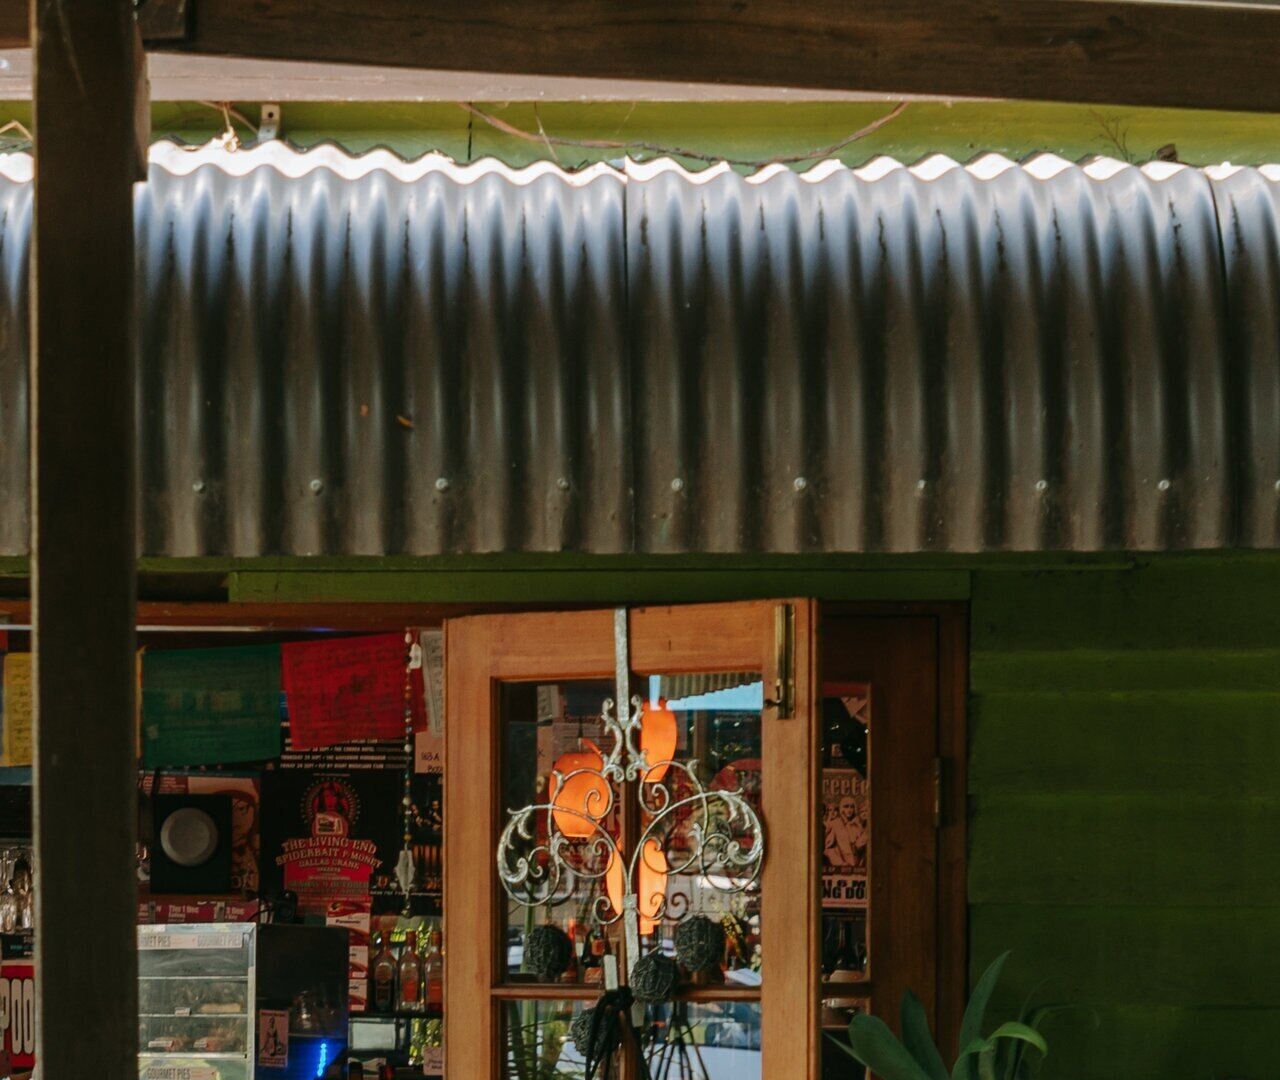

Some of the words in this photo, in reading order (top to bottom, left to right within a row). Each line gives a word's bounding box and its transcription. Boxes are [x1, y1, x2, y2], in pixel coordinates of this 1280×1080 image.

[281, 839, 306, 852] THE
[309, 837, 349, 848] LIVING
[353, 840, 377, 854] END
[275, 848, 340, 866] SPIDERBAIT
[299, 858, 329, 868] DALLAS
[332, 859, 360, 870] CRANE
[147, 1067, 176, 1080] GOURMET
[177, 1067, 191, 1080] PIES
